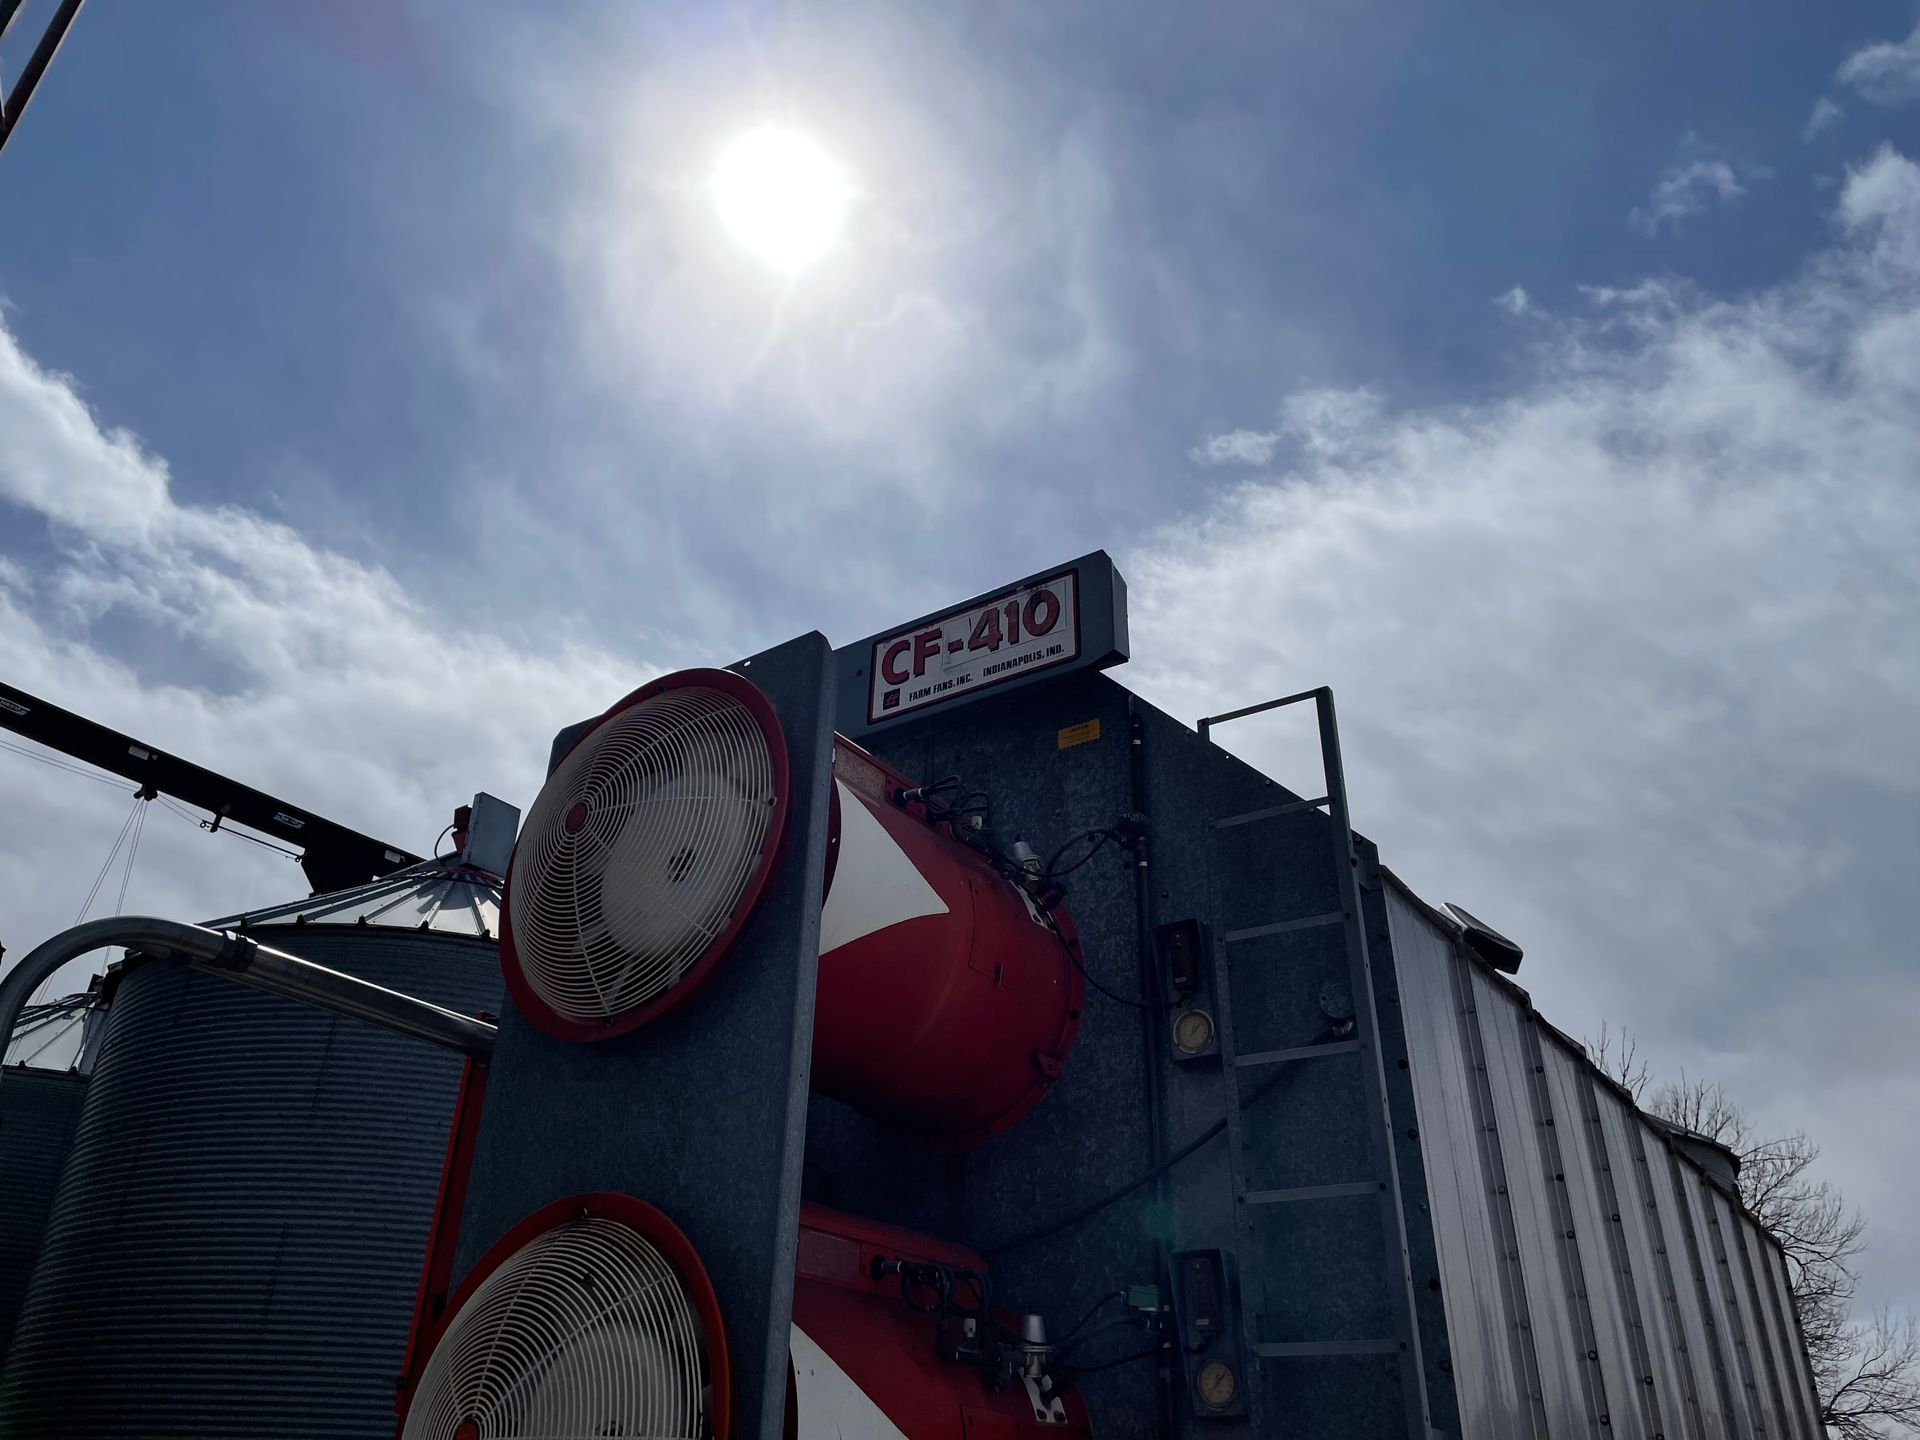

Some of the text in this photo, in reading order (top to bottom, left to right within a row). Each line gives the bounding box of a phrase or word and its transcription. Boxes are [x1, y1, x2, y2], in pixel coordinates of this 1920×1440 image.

[881, 589, 1061, 686] CF-410
[909, 686, 932, 702] FARM
[956, 673, 974, 687] INC.
[1046, 644, 1065, 657] IND.
